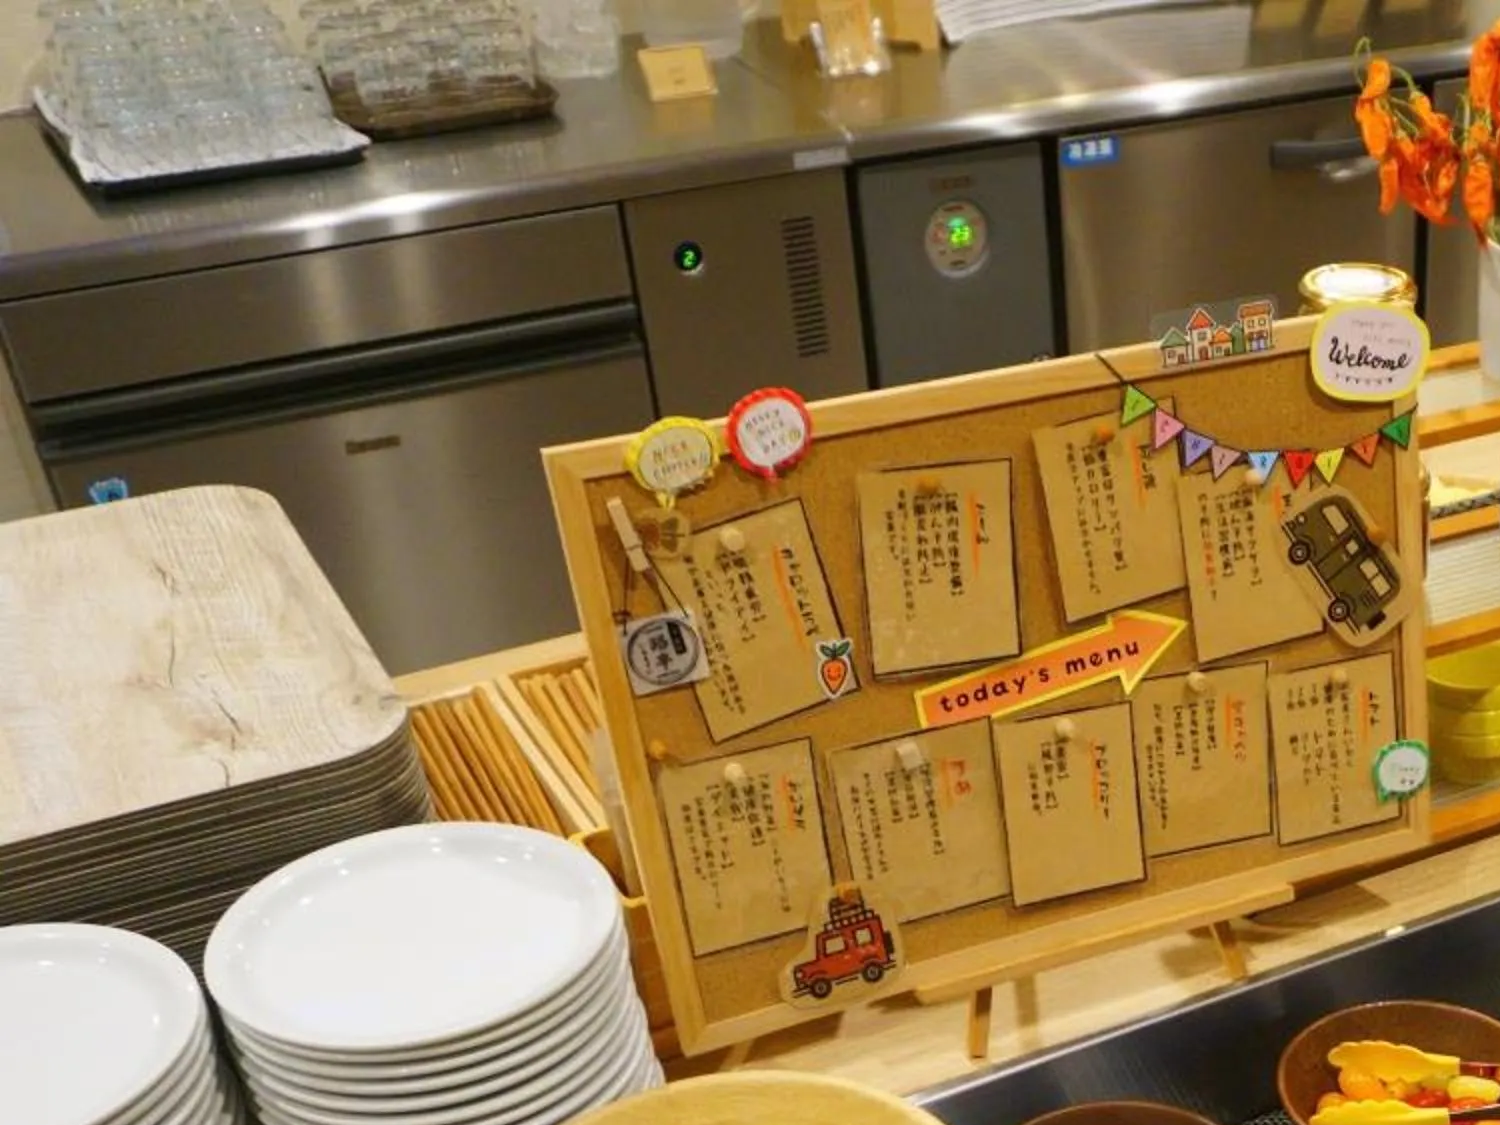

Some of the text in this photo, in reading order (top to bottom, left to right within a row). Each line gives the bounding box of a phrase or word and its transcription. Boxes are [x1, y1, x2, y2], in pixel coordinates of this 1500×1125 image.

[682, 249, 696, 268] 2
[1328, 335, 1413, 371] Welcome
[941, 642, 1139, 712] today's menu
[1369, 691, 1381, 727] トマト
